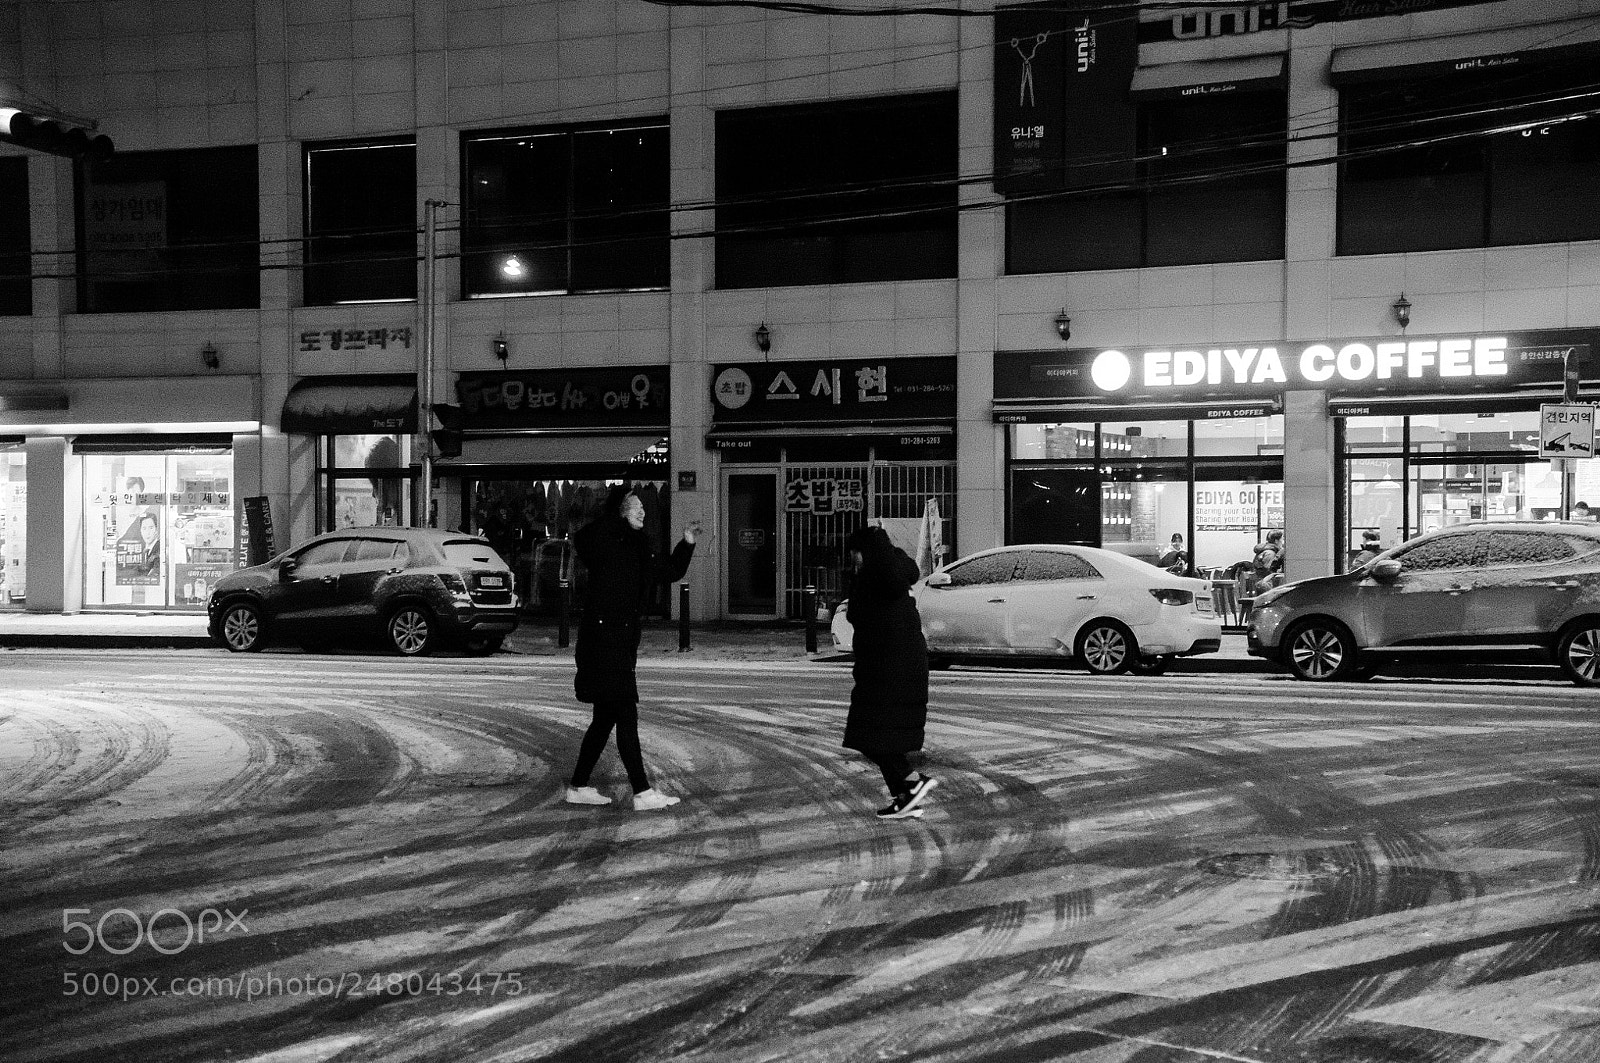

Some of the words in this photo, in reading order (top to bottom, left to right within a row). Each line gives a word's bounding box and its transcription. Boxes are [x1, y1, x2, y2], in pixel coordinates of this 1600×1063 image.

[300, 328, 411, 351] 도경프라자
[1142, 347, 1287, 387] EDIYA
[1299, 337, 1508, 383] COFFEE
[719, 379, 747, 395] 초밥
[765, 364, 888, 405] 스시현
[1207, 409, 1231, 417] EDIYA
[1233, 408, 1264, 417] COFFEE
[1545, 411, 1591, 424] 견인지역
[716, 440, 736, 448] Take
[737, 440, 752, 448] out
[787, 481, 836, 512] 초밥
[837, 481, 861, 497] 전문
[1196, 491, 1233, 505] EDIYA
